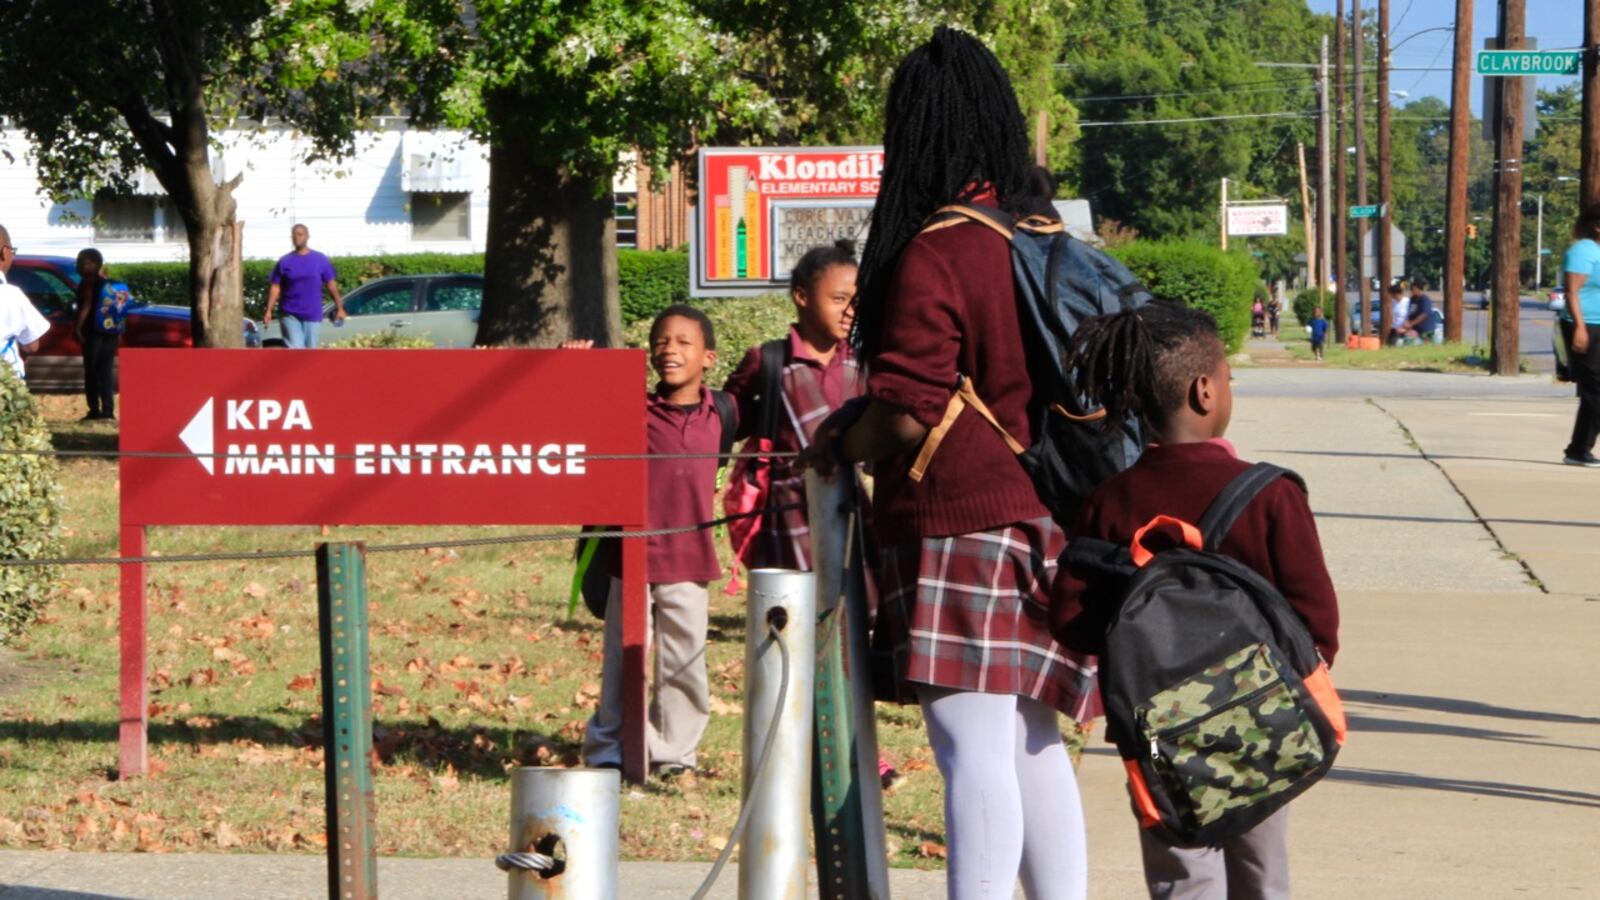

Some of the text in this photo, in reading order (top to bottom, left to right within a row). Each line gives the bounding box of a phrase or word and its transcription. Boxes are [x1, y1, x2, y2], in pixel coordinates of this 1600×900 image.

[1480, 55, 1574, 71] CLAYBROOK
[761, 181, 857, 194] ELEMENTARY
[785, 209, 825, 223] CORE
[787, 226, 855, 239] TEACHER
[226, 400, 313, 430] KPA
[224, 444, 587, 476] MAIN ENTRANCE
